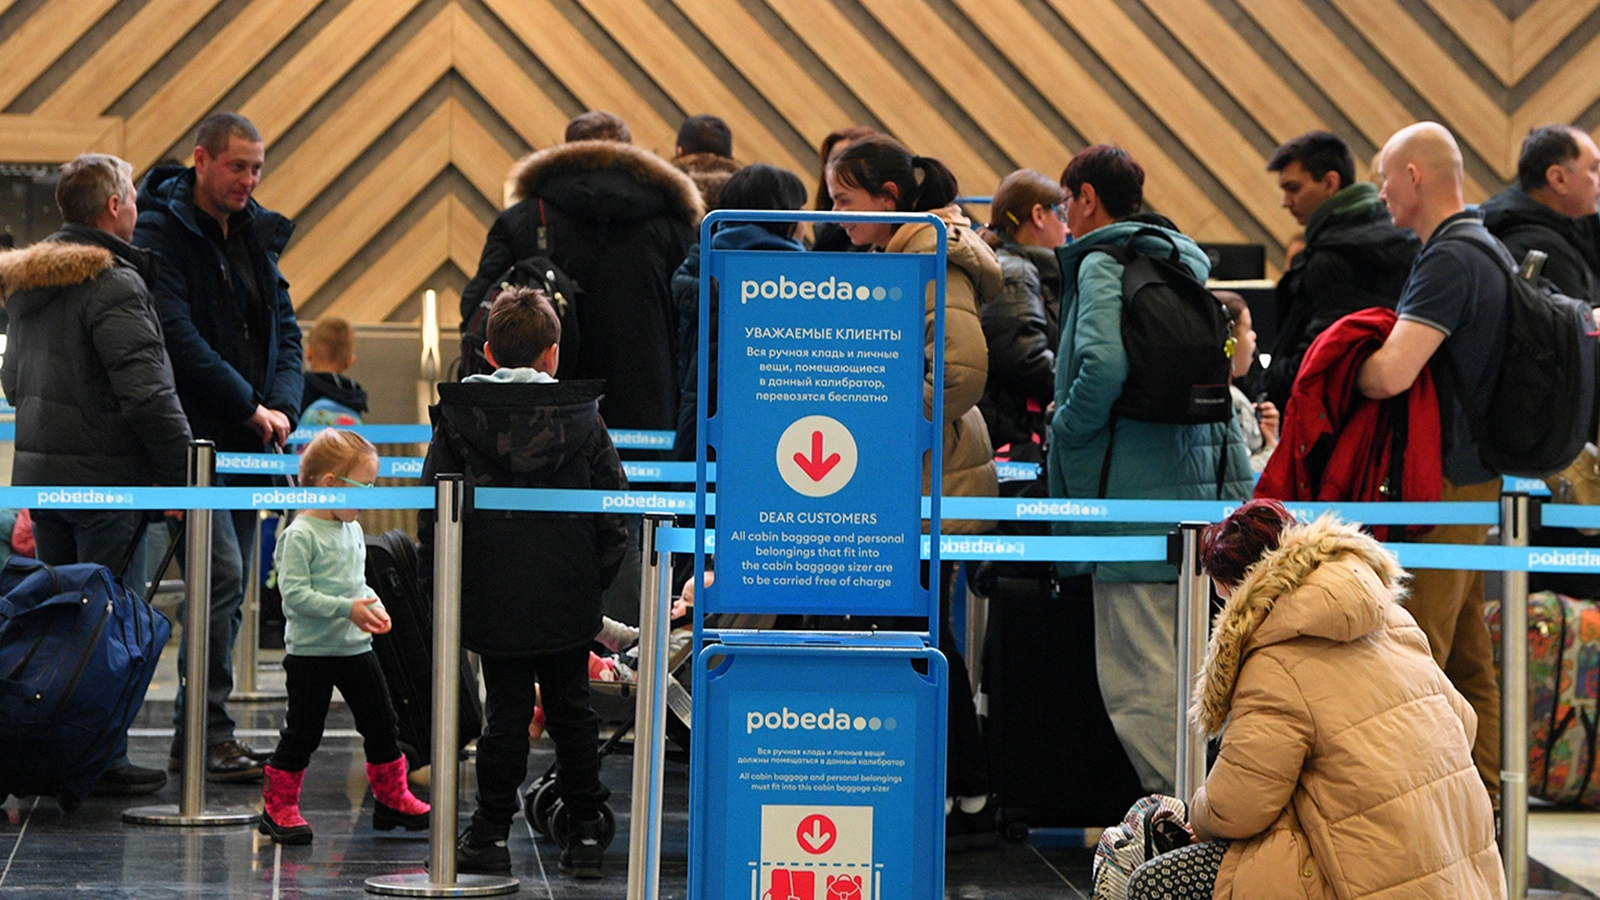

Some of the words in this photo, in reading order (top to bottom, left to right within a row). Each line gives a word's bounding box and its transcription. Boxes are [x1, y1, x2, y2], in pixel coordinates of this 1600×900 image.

[741, 275, 852, 304] pobeda
[745, 327, 832, 339] УВАЖАЕМЫЕ
[836, 328, 901, 340] КЛИЕНТЫ
[747, 347, 766, 356] Вся
[769, 349, 809, 360] ручная
[812, 350, 845, 359] кладь
[857, 351, 899, 359] личные
[760, 364, 792, 373] вещи,
[795, 364, 885, 374] помещающиеся
[768, 377, 812, 387] данный
[815, 378, 884, 389] калибратор,
[756, 393, 825, 402] перевозятся
[828, 392, 888, 402] бесплатно
[216, 455, 260, 469] beda
[392, 459, 422, 475] pob
[38, 489, 104, 506] pobeda
[252, 489, 318, 507] pobeda
[602, 493, 667, 510] pobeda
[1016, 501, 1081, 518] pobeda
[760, 512, 794, 523] DEAR
[797, 512, 877, 524] CUSTOMERS
[731, 531, 746, 541] All
[748, 532, 779, 541] cabin
[782, 532, 830, 544] baggage
[833, 533, 855, 543] and
[857, 534, 904, 545] personal
[756, 547, 815, 559] belongings
[818, 547, 841, 557] that
[844, 548, 856, 557] fit
[859, 548, 879, 557] into
[1528, 550, 1600, 569] pobeda
[742, 561, 759, 570] the
[762, 561, 793, 571] cabin
[796, 562, 845, 573] baggage
[848, 563, 872, 572] sizer
[875, 564, 893, 572] are
[757, 575, 770, 585] be
[773, 575, 812, 586] carried
[815, 576, 836, 586] free
[839, 576, 851, 586] of
[853, 576, 891, 589] charge
[747, 707, 850, 734] pobeda
[774, 773, 808, 782] baggage
[827, 774, 859, 783] personal
[861, 774, 902, 783] belongings
[751, 783, 770, 791] must
[772, 783, 780, 791] fit
[813, 784, 834, 792] cabin
[836, 784, 871, 793] baggage
